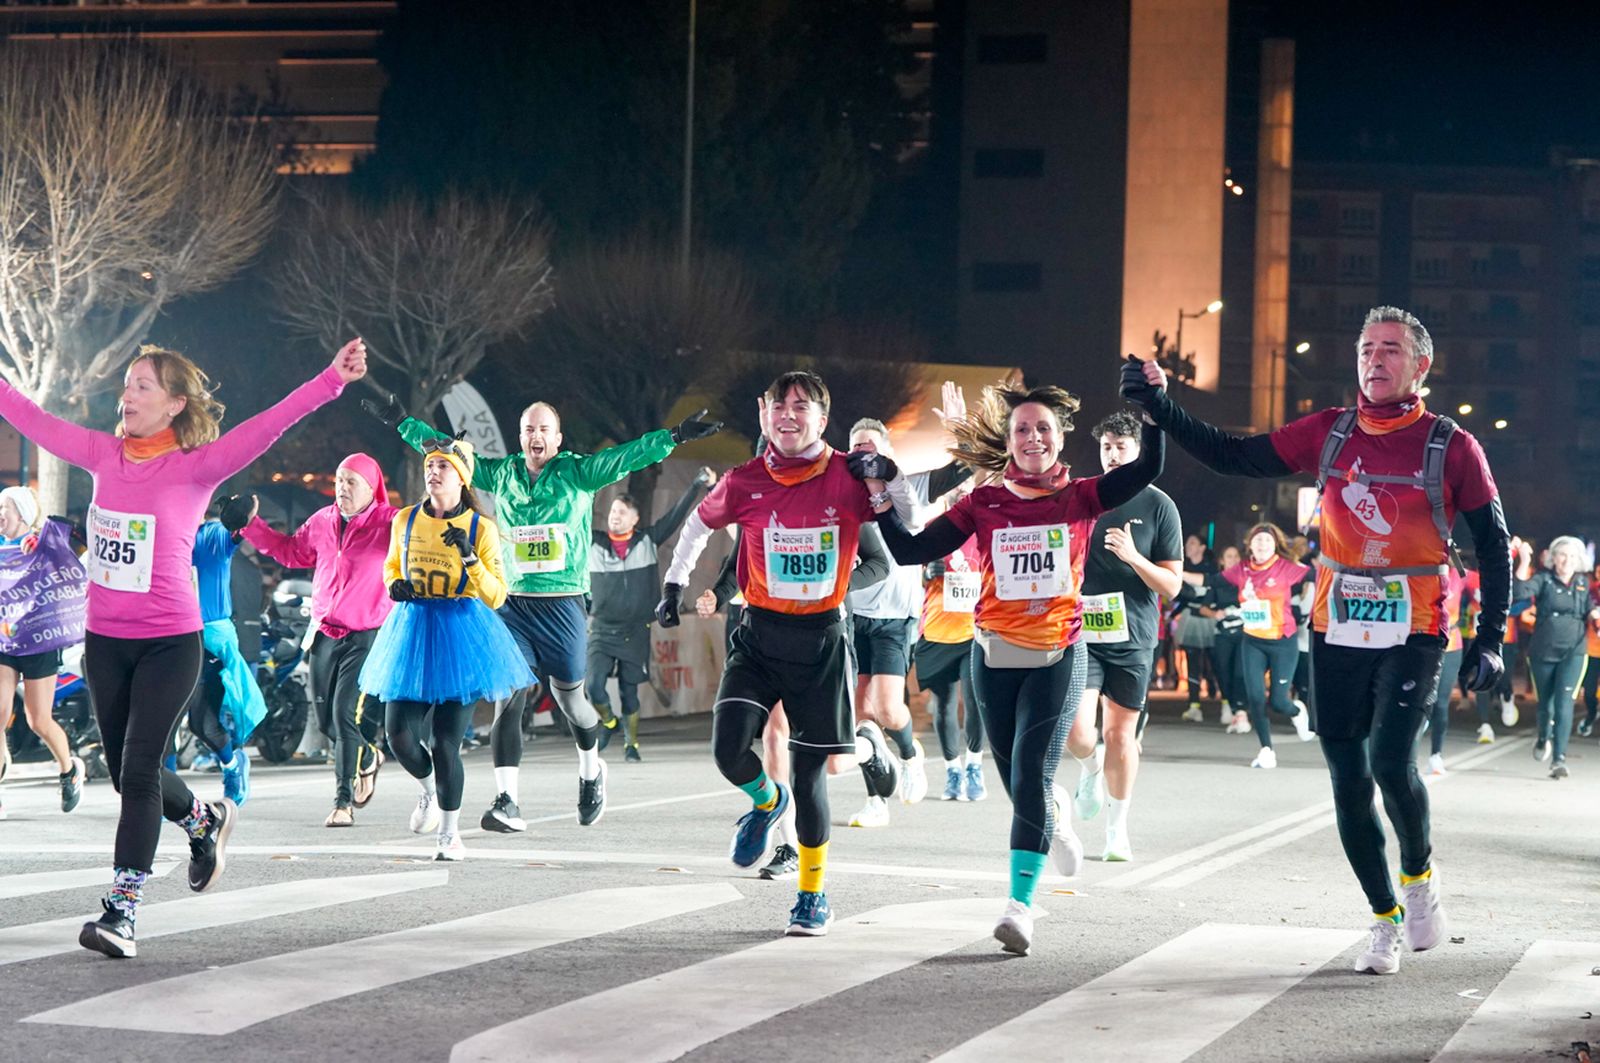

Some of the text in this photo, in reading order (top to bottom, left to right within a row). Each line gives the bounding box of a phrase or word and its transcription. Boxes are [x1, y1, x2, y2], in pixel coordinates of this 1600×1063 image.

[1355, 498, 1376, 520] 43
[805, 536, 814, 544] DE
[1008, 534, 1030, 543] NOCHE
[1032, 532, 1041, 541] DE
[95, 534, 136, 565] 3235
[528, 541, 550, 557] 218
[774, 544, 815, 553] SAN ANTÓN
[1000, 542, 1042, 553] SAN ANTÓN
[780, 553, 827, 575] 7898
[1009, 551, 1055, 575] 7704
[8, 584, 32, 600] UN
[33, 566, 83, 595] SUEÑO
[1343, 583, 1377, 593] NOCHE DE
[952, 586, 978, 599] 6120
[1343, 598, 1398, 623] 12221
[1083, 612, 1114, 627] 1768
[32, 624, 71, 643] DONA
